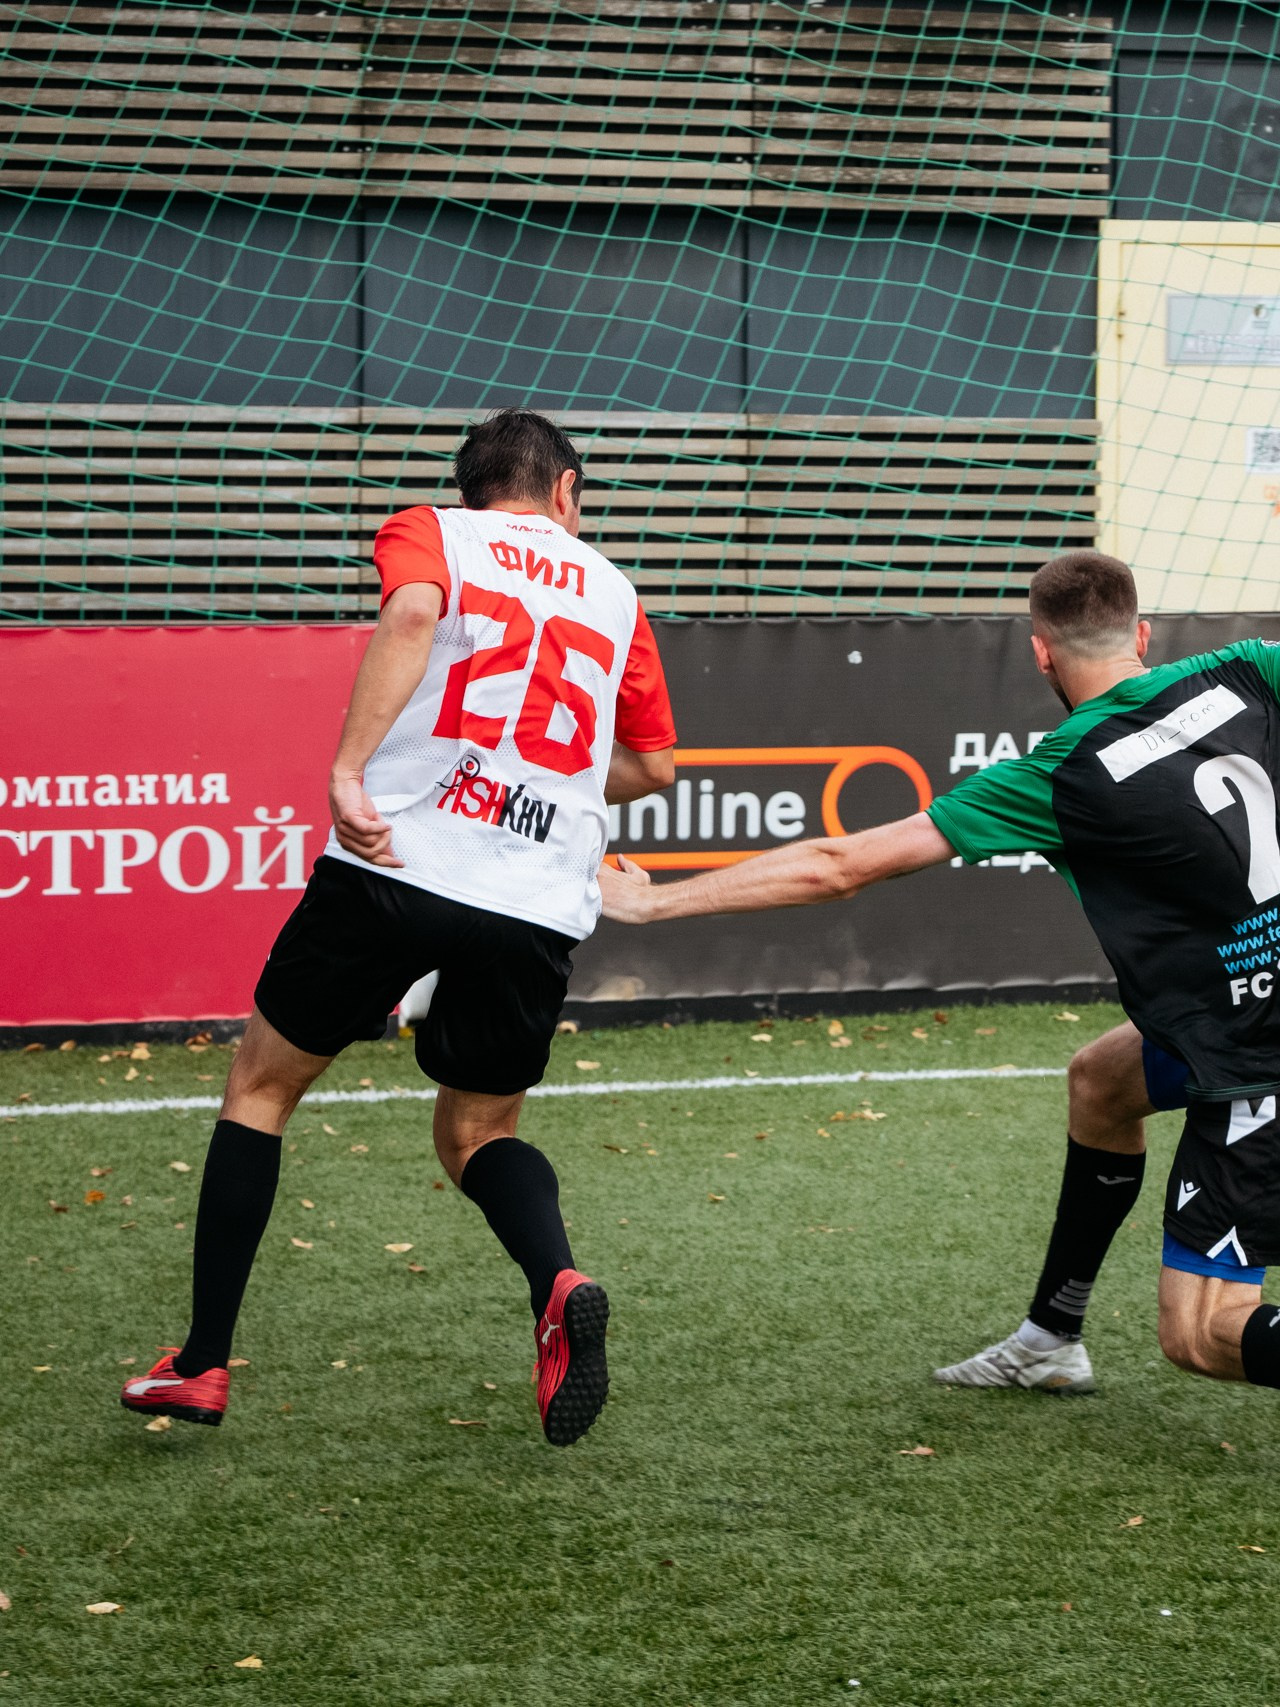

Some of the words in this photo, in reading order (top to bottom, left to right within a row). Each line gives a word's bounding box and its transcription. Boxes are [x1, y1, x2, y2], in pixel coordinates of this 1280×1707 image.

[489, 540, 585, 598] ФИЛ
[432, 581, 615, 776] 26
[1229, 971, 1274, 1005] FC
